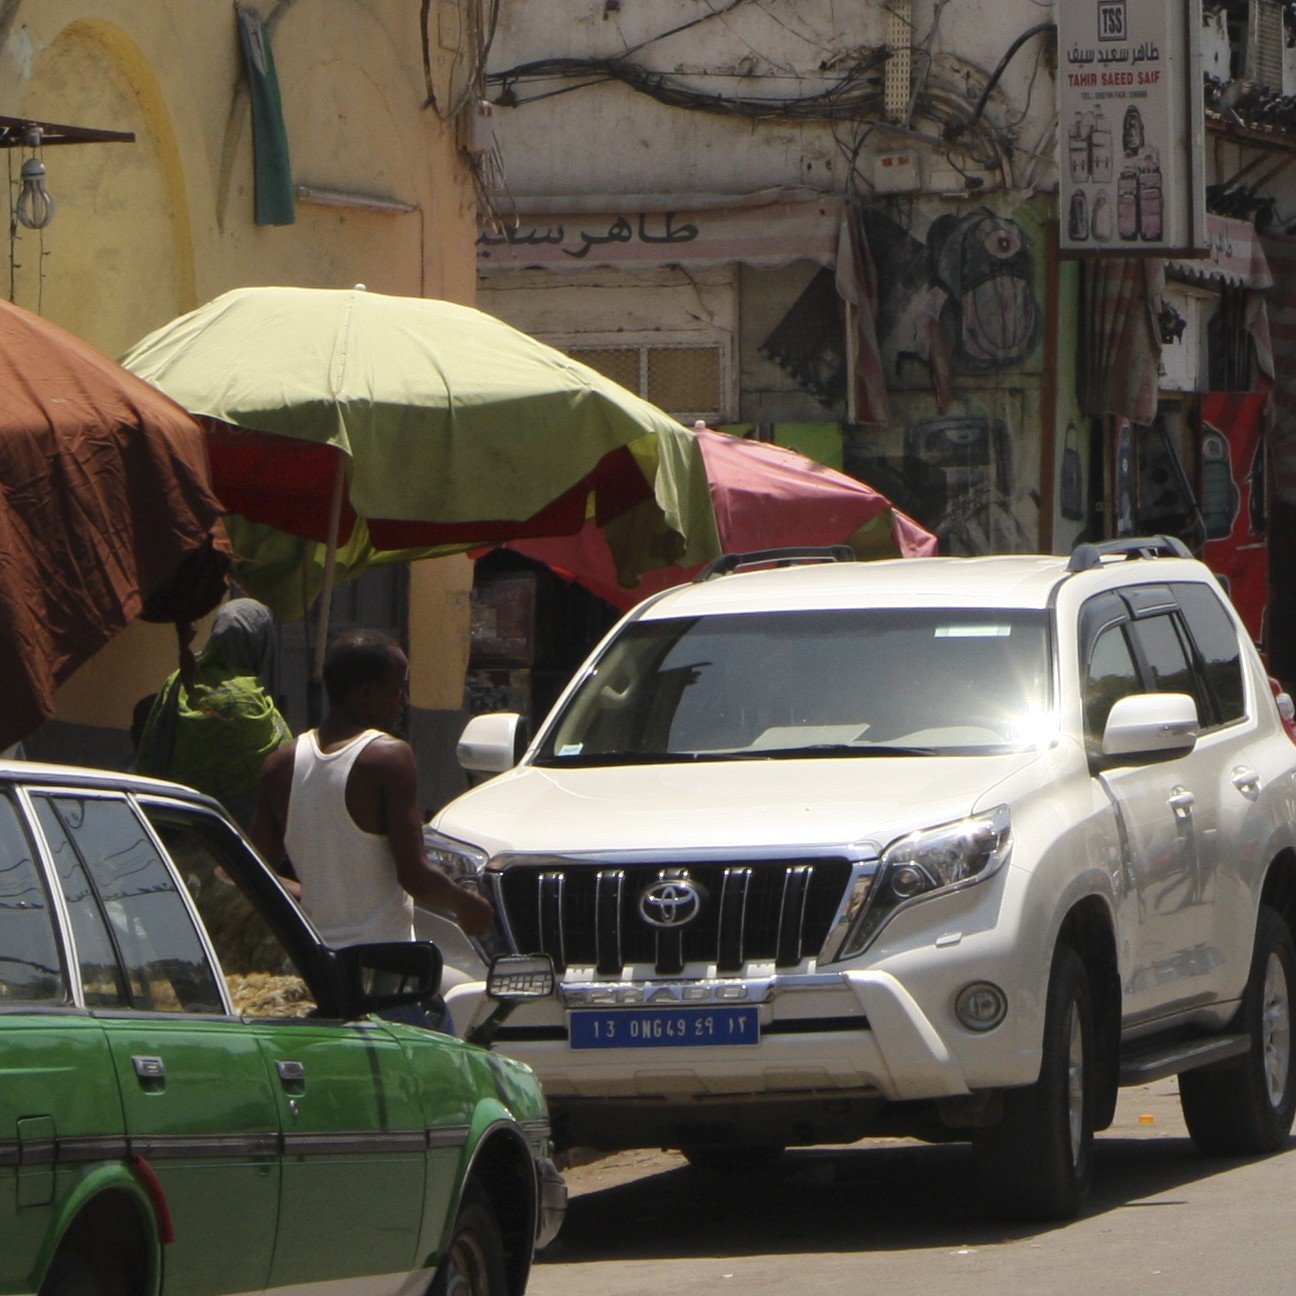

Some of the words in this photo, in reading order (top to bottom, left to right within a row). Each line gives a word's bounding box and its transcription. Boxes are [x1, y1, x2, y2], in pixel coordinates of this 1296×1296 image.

[1102, 7, 1122, 34] TSS
[1068, 73, 1097, 87] TAHIR
[1101, 72, 1133, 86] SAEED
[1138, 70, 1160, 85] SAIF
